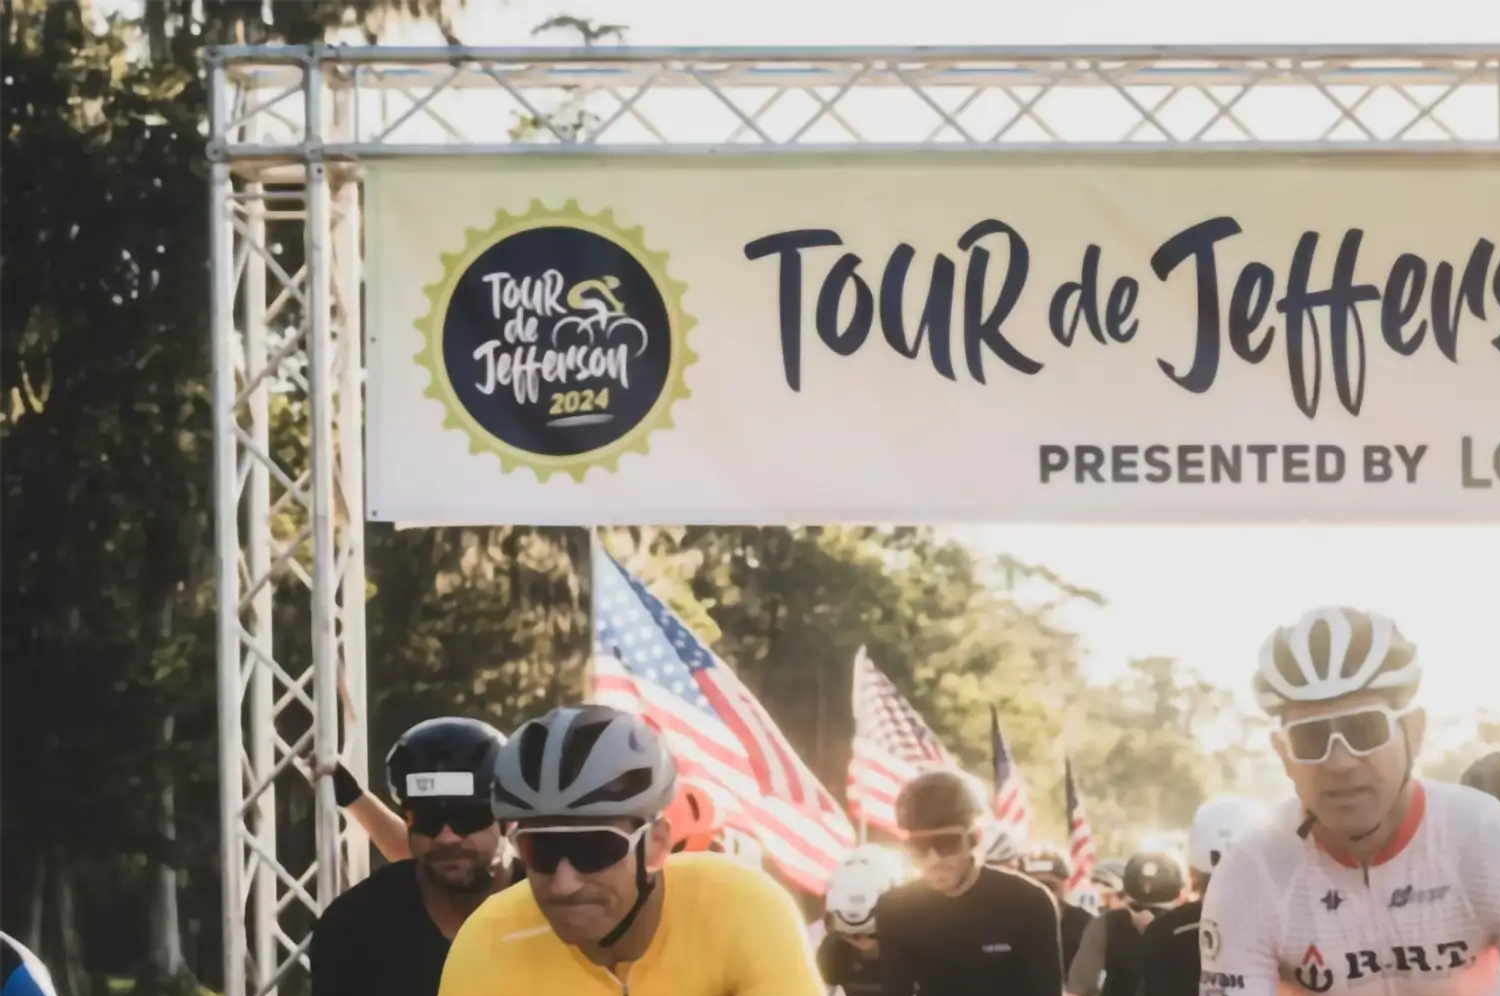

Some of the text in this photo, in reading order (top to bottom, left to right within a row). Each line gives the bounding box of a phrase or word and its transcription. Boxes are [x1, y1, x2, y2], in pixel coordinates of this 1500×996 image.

[1049, 244, 1138, 347] de
[504, 306, 539, 344] de
[473, 339, 630, 405] Jefferson
[549, 387, 609, 415] 2024
[1038, 444, 1346, 484] PRESENTED
[1363, 444, 1428, 483] BY
